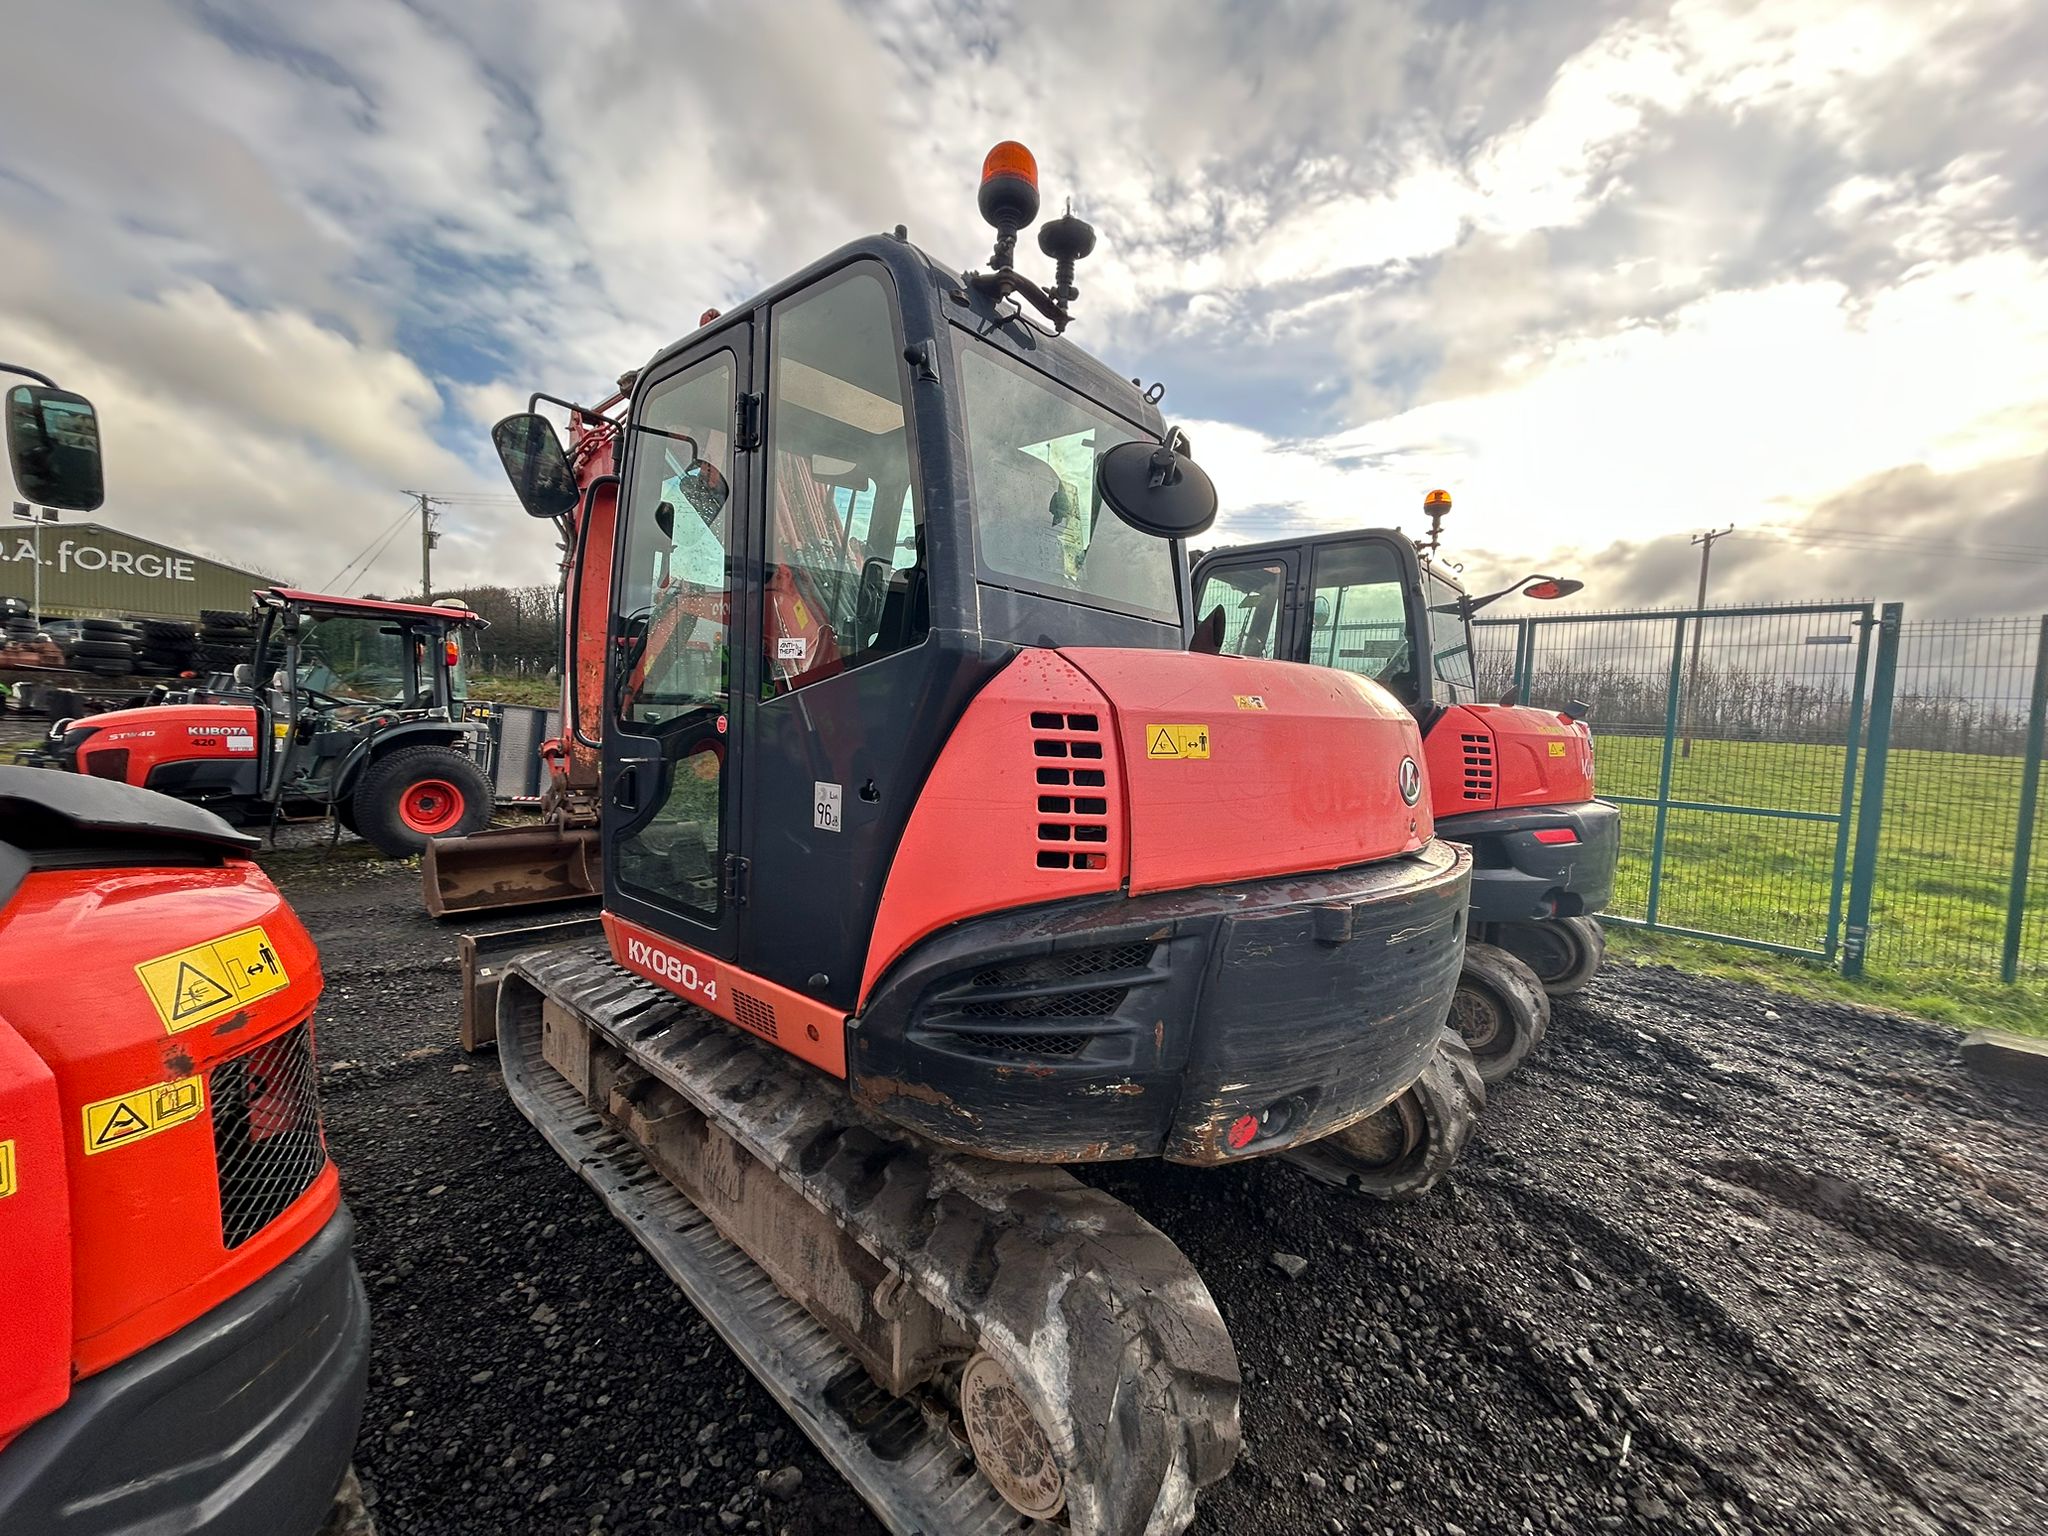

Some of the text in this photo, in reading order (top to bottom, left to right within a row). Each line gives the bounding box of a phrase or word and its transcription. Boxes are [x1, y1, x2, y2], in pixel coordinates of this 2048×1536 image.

[0, 538, 53, 565] .A.
[188, 726, 249, 736] KUBOTA
[191, 738, 216, 747] 420
[817, 803, 831, 825] 96
[628, 937, 717, 1001] KX080-4
